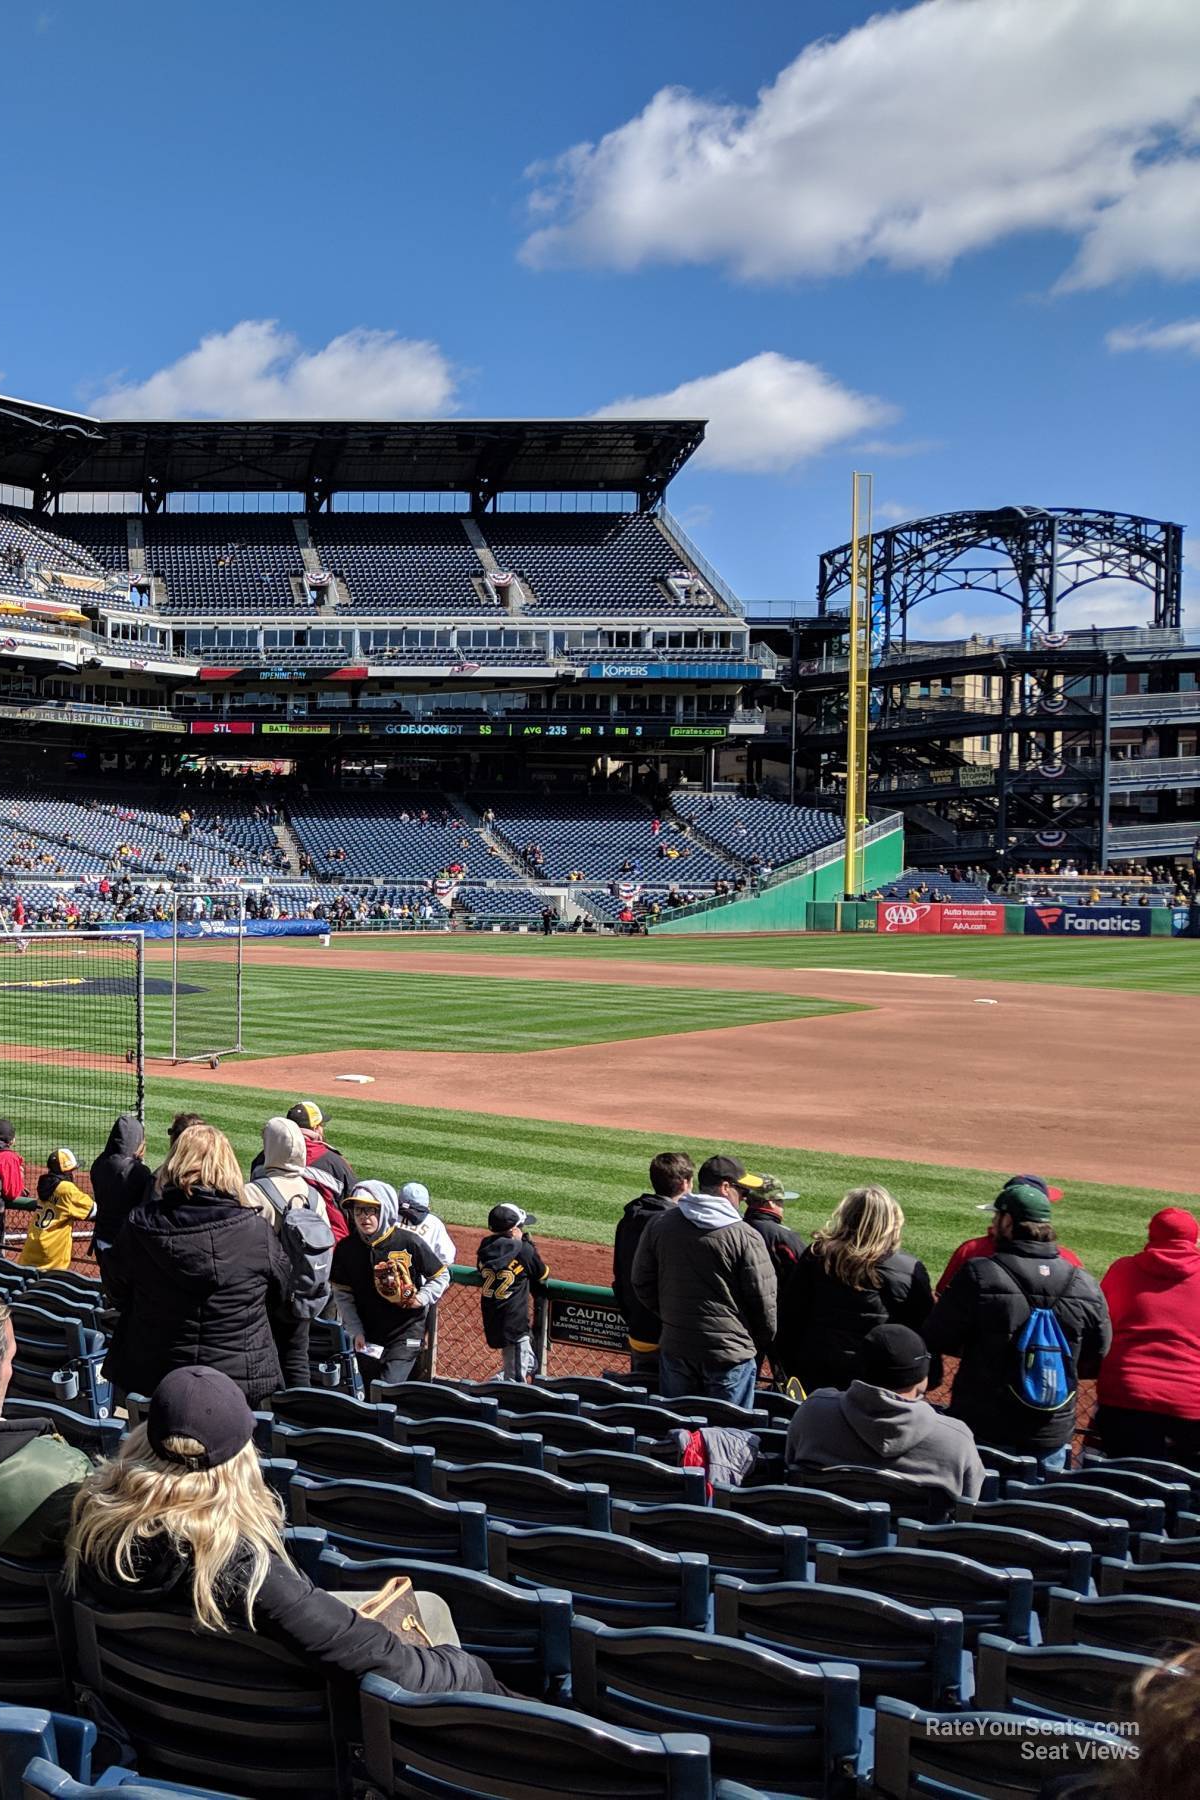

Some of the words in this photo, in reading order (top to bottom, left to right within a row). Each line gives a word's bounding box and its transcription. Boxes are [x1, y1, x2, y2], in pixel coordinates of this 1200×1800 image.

[602, 665, 648, 677] KOPPERS
[57, 713, 87, 723] LATEST
[89, 714, 120, 726] PIRATES
[122, 718, 145, 728] NEWS
[213, 724, 232, 733] STL
[479, 725, 492, 734] SS
[545, 725, 568, 735] .235
[614, 727, 629, 735] RBI
[674, 727, 722, 736] pirates.com
[889, 909, 913, 923] AAA
[1064, 913, 1141, 931] Fanatics
[858, 919, 876, 928] 325
[481, 1268, 515, 1299] 22
[566, 1306, 626, 1325] CAUTION
[569, 1317, 589, 1325] ALERT
[553, 1321, 579, 1330] LEAVING
[594, 1328, 621, 1337] PLAYING
[580, 1336, 623, 1347] TRESPASSING
